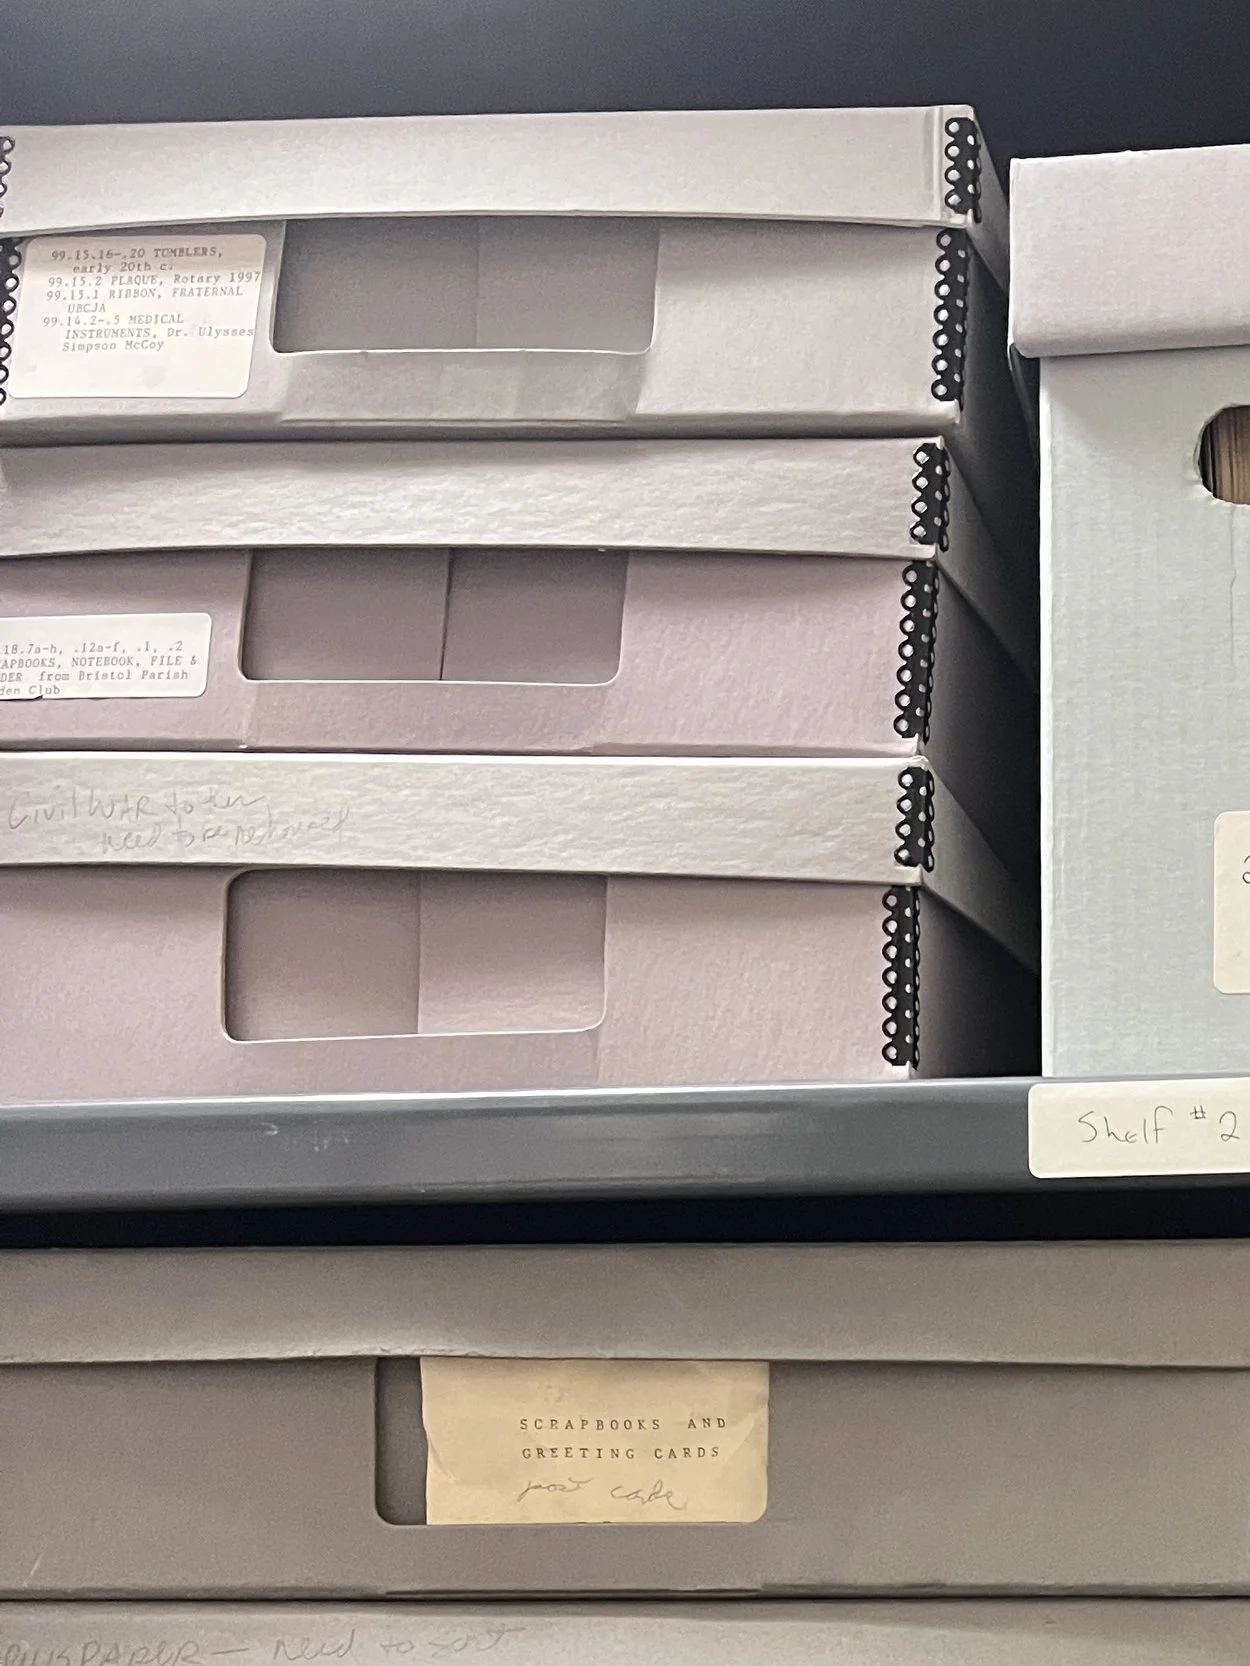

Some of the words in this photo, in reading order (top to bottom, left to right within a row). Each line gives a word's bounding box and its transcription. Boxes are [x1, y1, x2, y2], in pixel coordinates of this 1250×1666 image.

[153, 247, 222, 258] TUMBLERS,
[72, 262, 112, 274] early
[120, 261, 151, 272] 20th
[160, 263, 173, 271] c.
[48, 276, 102, 287] 99.15.2
[111, 275, 163, 286] PLAQUE,
[173, 274, 221, 285] Rotary
[229, 272, 261, 283] 1997
[46, 289, 98, 301] 99.15.1
[109, 288, 161, 299] RIBBON,
[172, 286, 243, 297] FRATERNAL
[67, 303, 106, 313] UBCJA
[129, 314, 184, 325] MEDICAL
[65, 328, 156, 340] INSTRUMENTS,
[167, 327, 188, 337] Dr.
[198, 326, 255, 339] Ulysses
[62, 342, 117, 353] Simpson
[125, 340, 164, 351] McCoy
[72, 656, 140, 667] NOTEBOOK,
[150, 655, 183, 666] FILE
[39, 671, 70, 681] from
[79, 669, 131, 680] Bristol
[141, 669, 188, 680] Parish
[28, 684, 60, 694] Club
[1078, 1105, 1173, 1144] Shelf
[519, 1418, 662, 1431] SCRAPBOOKS
[687, 1417, 728, 1429] AND
[522, 1447, 637, 1460] GREETING
[654, 1446, 720, 1459] CARDS
